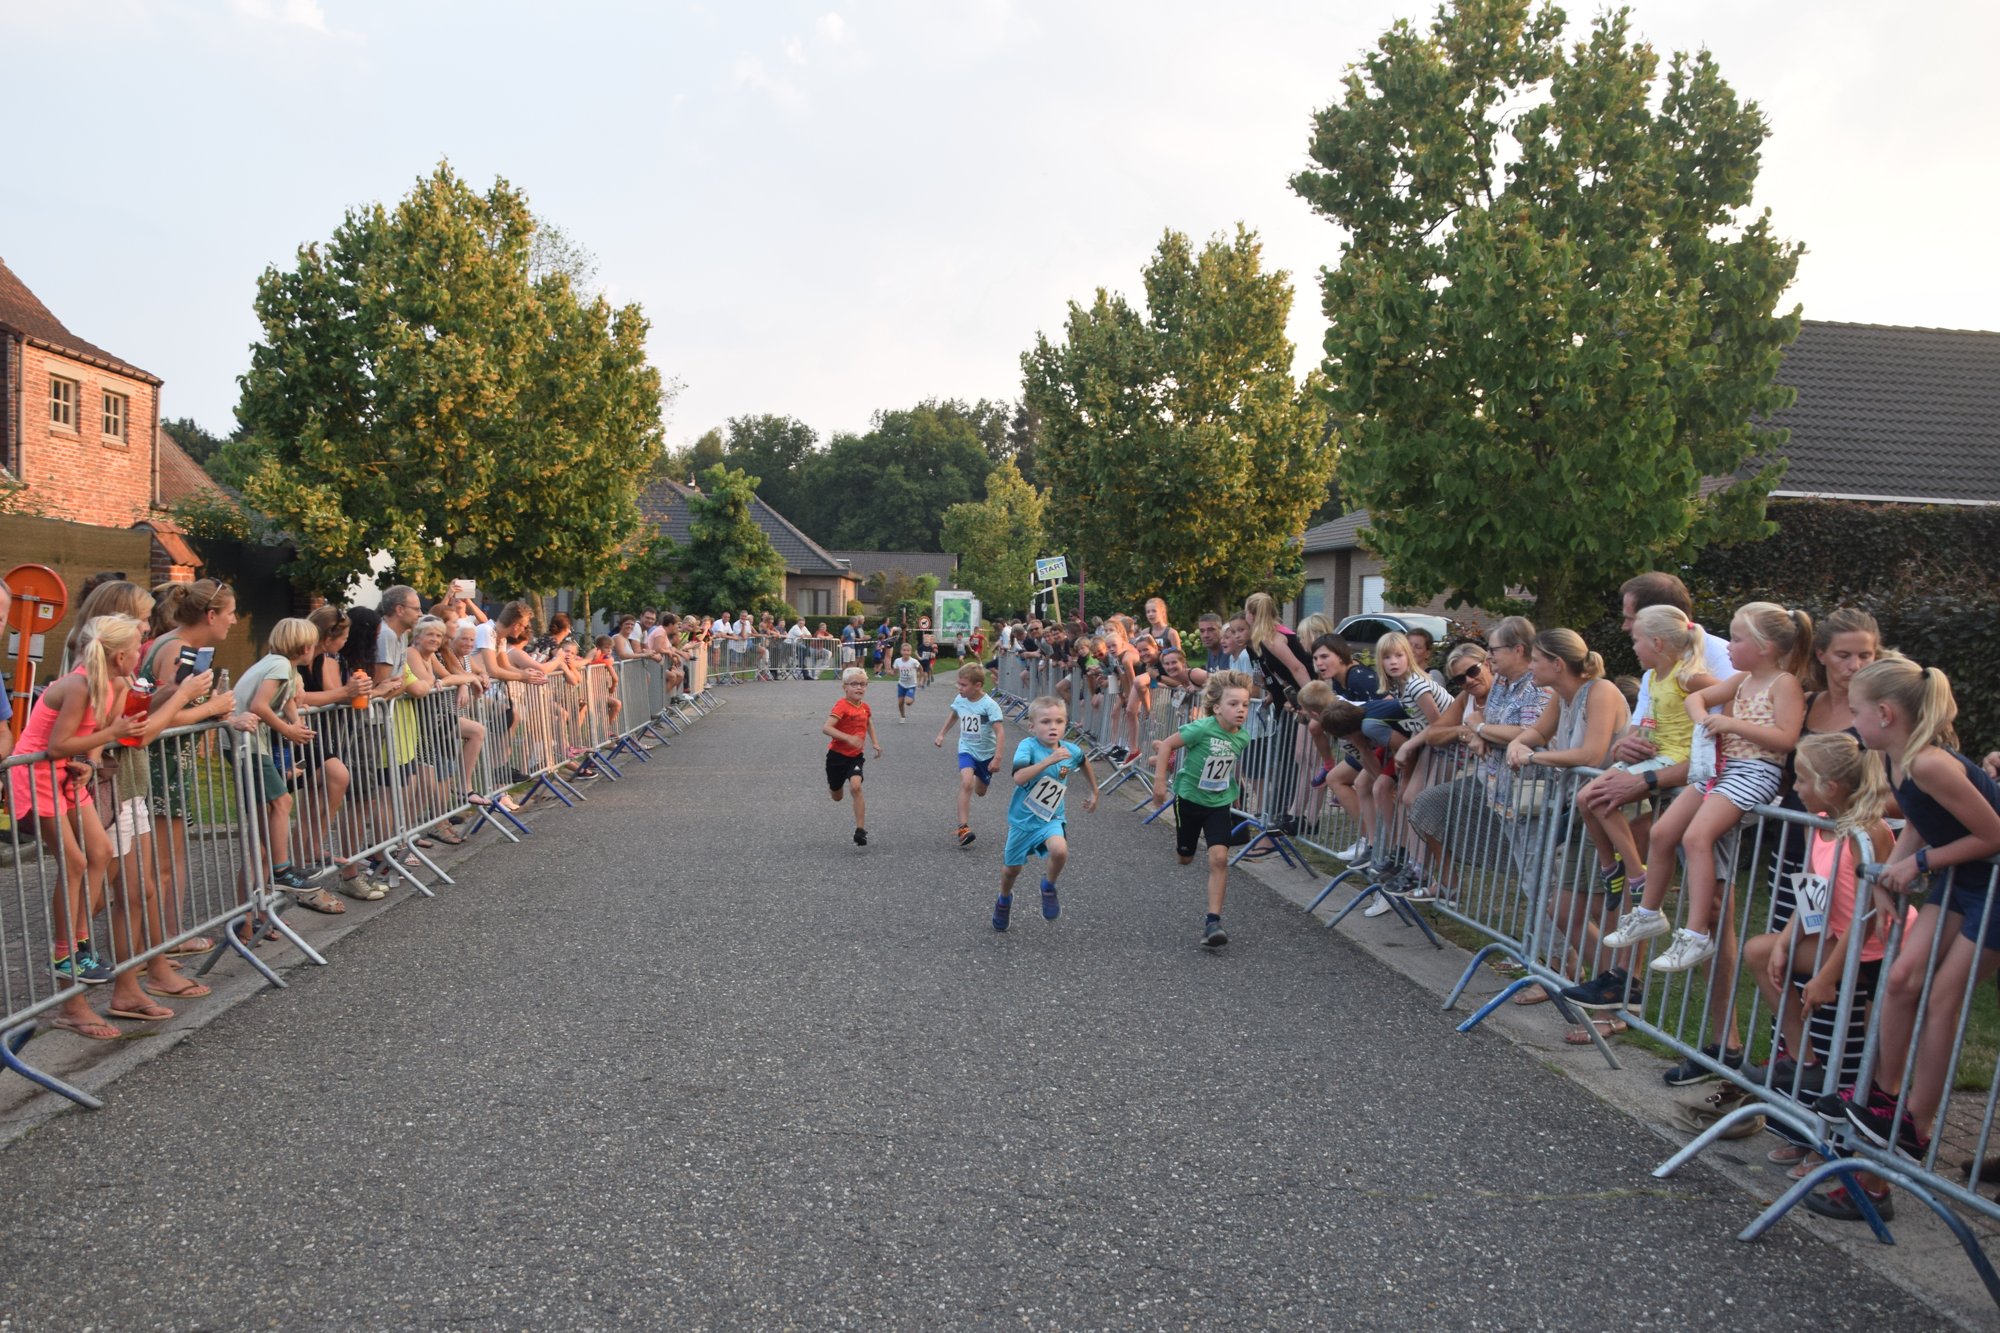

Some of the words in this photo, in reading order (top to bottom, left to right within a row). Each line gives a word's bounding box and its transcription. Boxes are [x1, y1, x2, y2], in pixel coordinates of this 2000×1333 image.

[1039, 561, 1065, 575] START
[962, 716, 979, 732] 123
[1207, 760, 1233, 779] 127
[1035, 780, 1064, 809] 121
